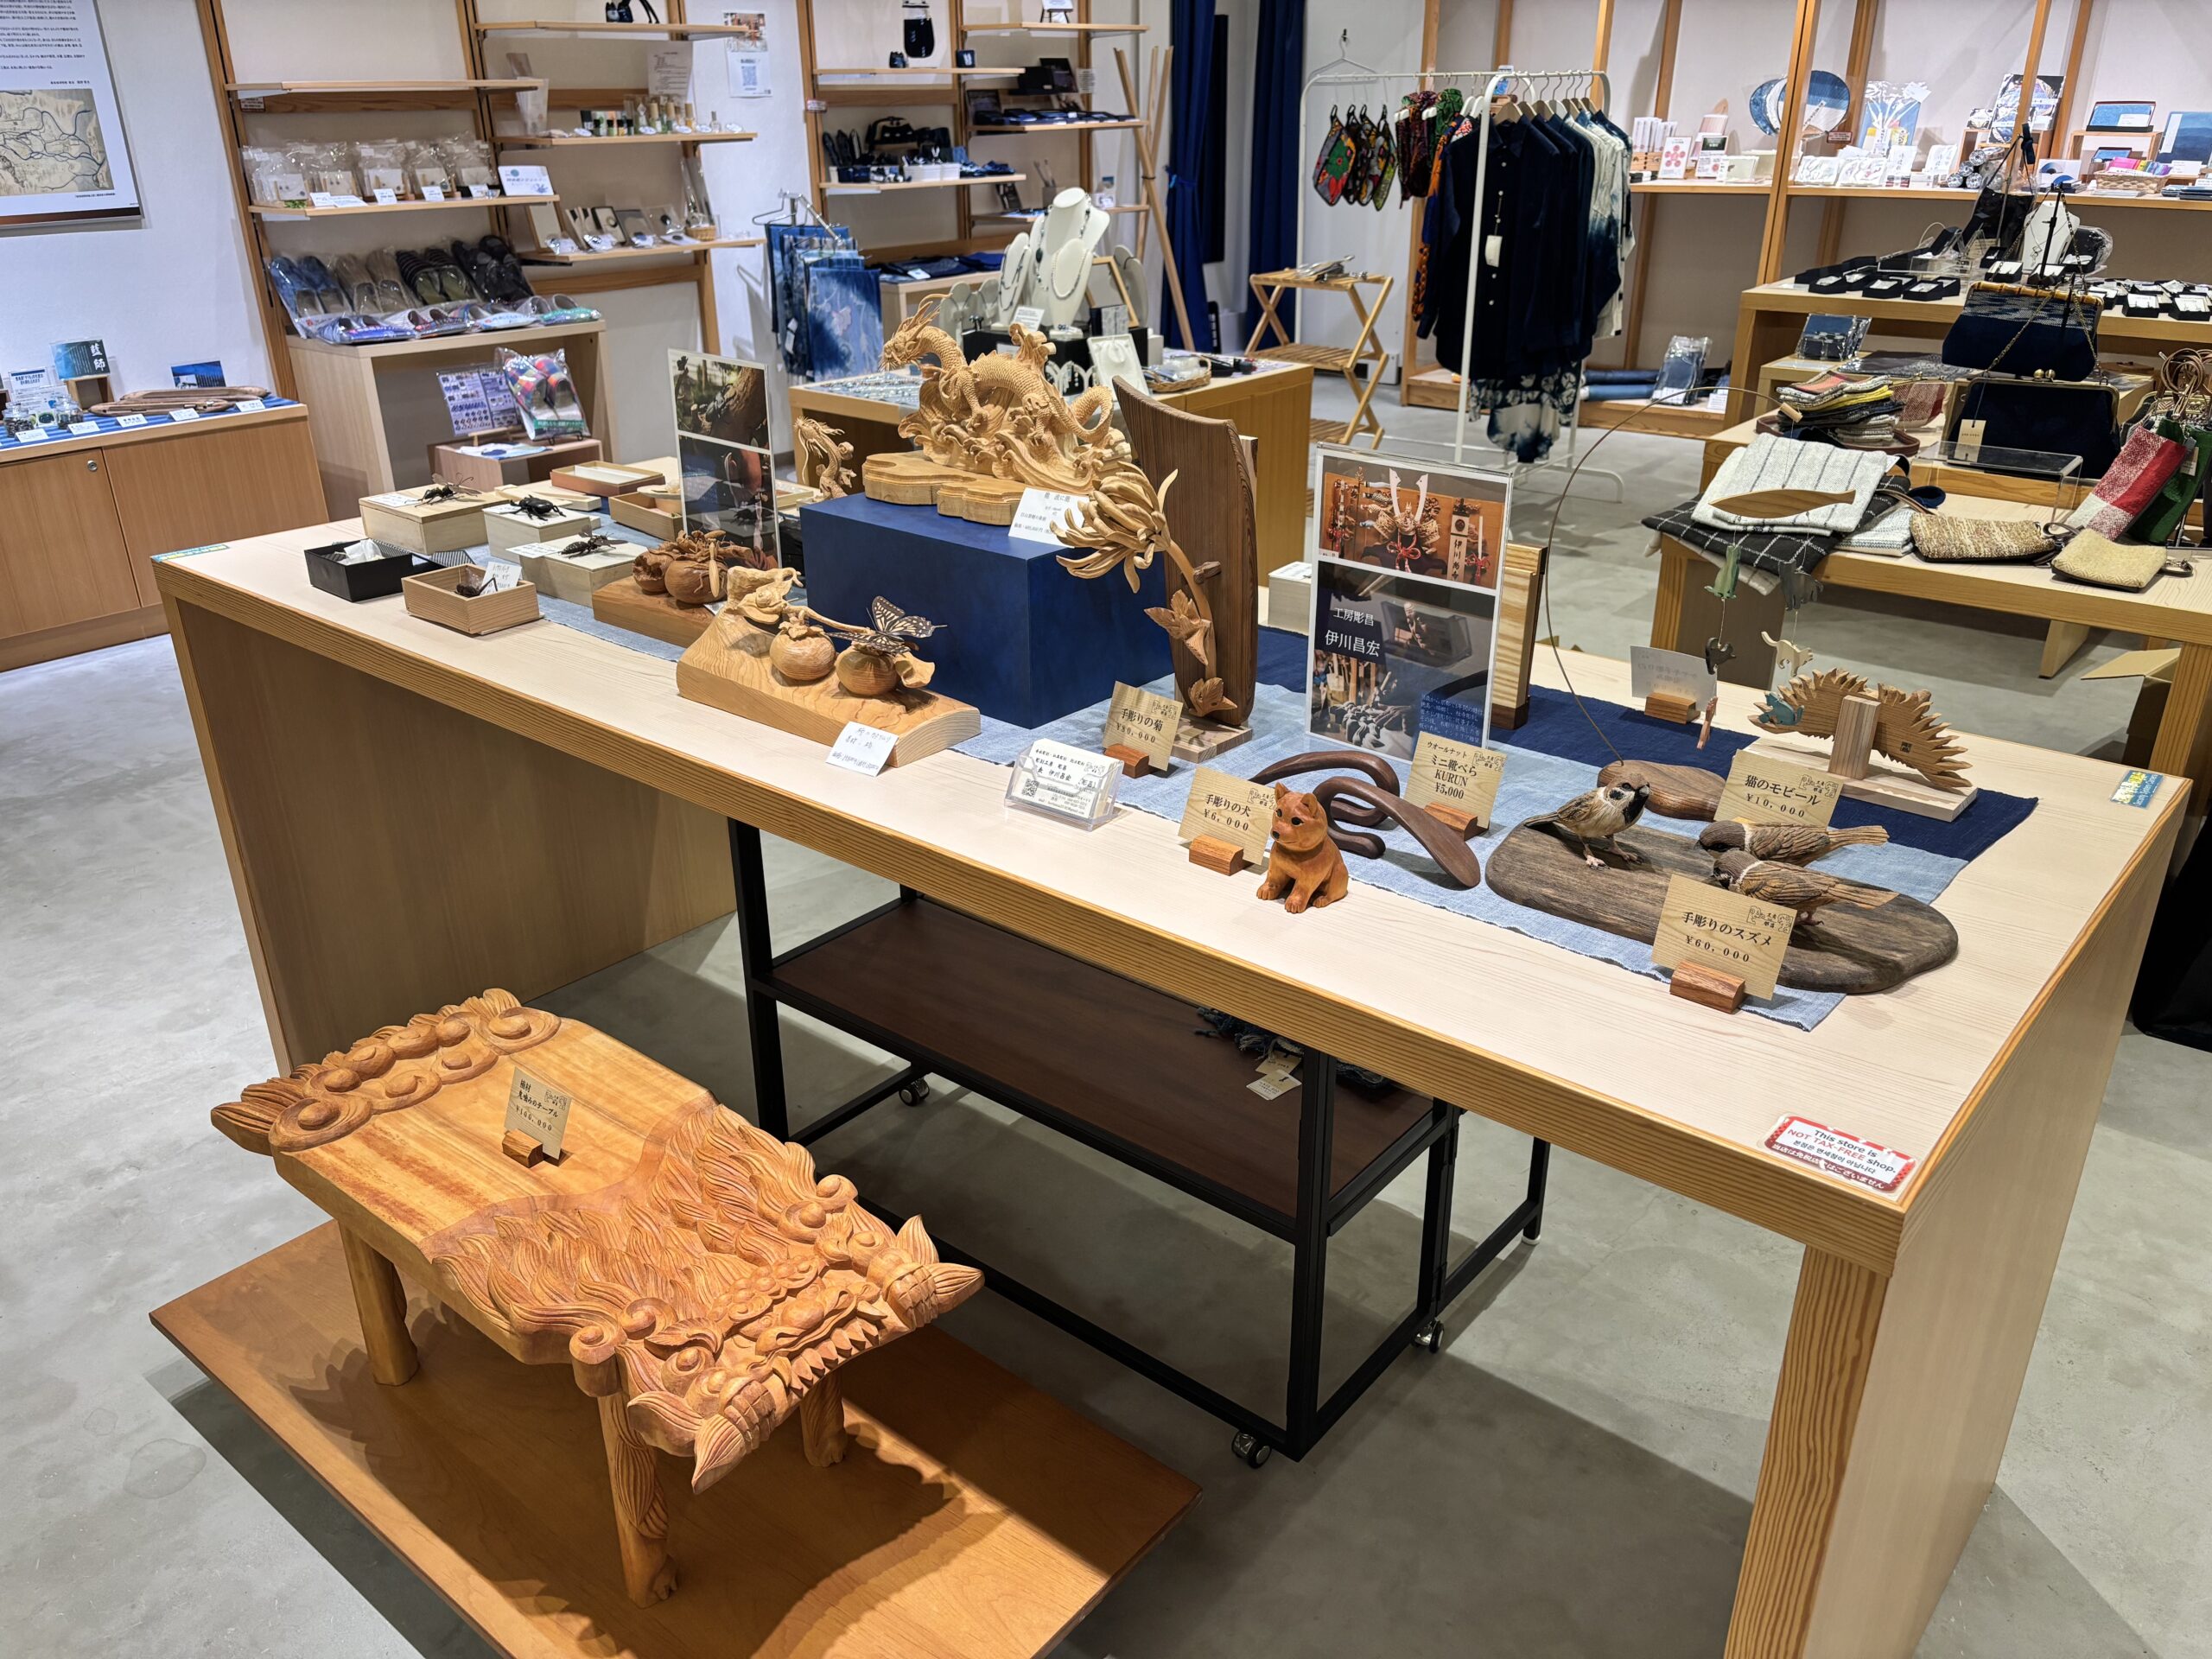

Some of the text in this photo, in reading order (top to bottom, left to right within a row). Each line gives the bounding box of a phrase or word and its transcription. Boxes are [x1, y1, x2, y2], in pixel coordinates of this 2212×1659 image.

[1333, 607, 1374, 626] 工房彫昌
[1325, 630, 1380, 657] 伊川昌宏
[1122, 709, 1164, 732] 手彫りの菊
[1432, 754, 1477, 777] ミニ靴べら
[1434, 769, 1468, 787] KURUN
[1435, 782, 1465, 800] ¥5,000
[1745, 774, 1821, 806] 猫のモビール
[1205, 794, 1251, 817] 手彫りの犬
[1682, 912, 1772, 946] 手彫りのスズメ
[1788, 1129, 1897, 1174] NOT TAX-FREE shop.
[1815, 1130, 1878, 1158] This store is
[1772, 1143, 1885, 1190] 当店は免税店はございません
